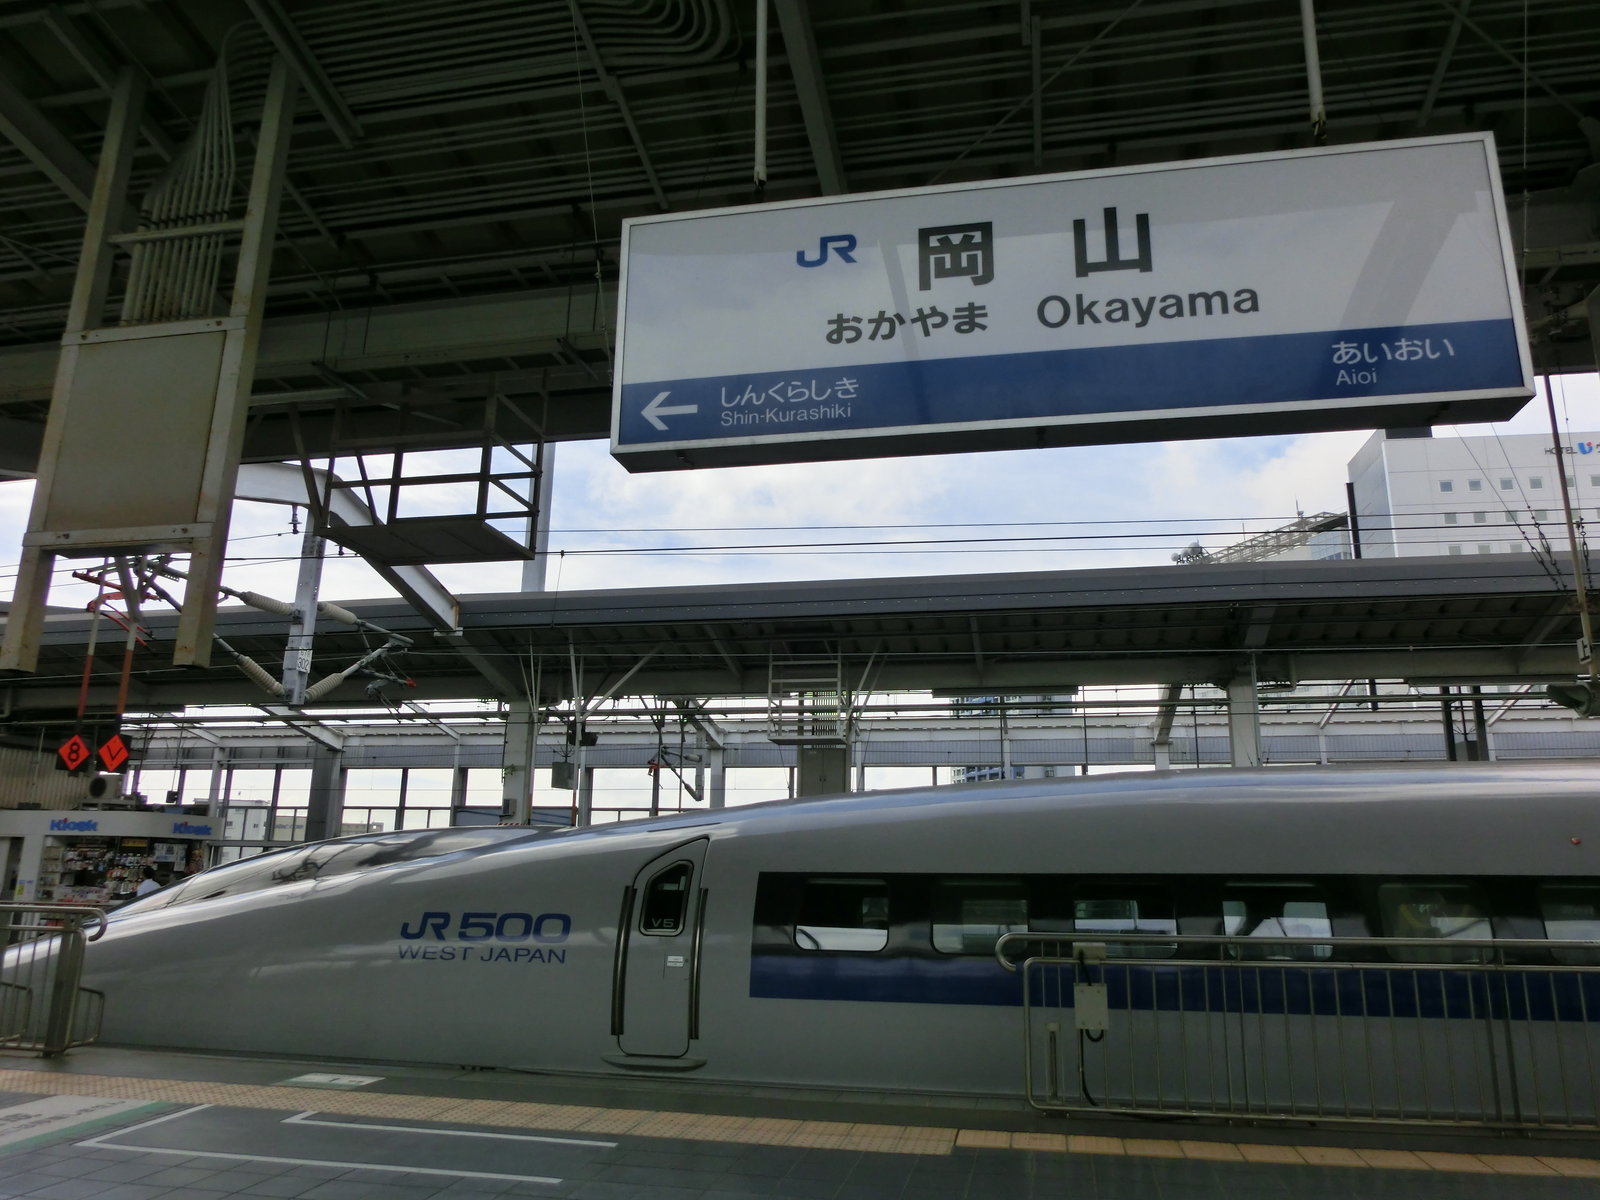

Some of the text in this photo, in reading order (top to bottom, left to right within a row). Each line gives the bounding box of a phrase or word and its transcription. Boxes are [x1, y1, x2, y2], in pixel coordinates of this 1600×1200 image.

[796, 233, 857, 268] JR
[1036, 287, 1260, 329] Okayama
[825, 302, 989, 345] おかやま
[1331, 336, 1456, 366] あいおい
[1335, 367, 1378, 386] Aioi
[720, 377, 860, 408] しんくらしき
[720, 402, 852, 427] Shin-Kurashiki
[68, 742, 80, 763] 8
[50, 817, 98, 832] Kiosk
[172, 820, 213, 836] Kiosk
[400, 911, 572, 944] JR 500
[651, 917, 675, 928] V5
[398, 944, 567, 964] WEST JAPAN
